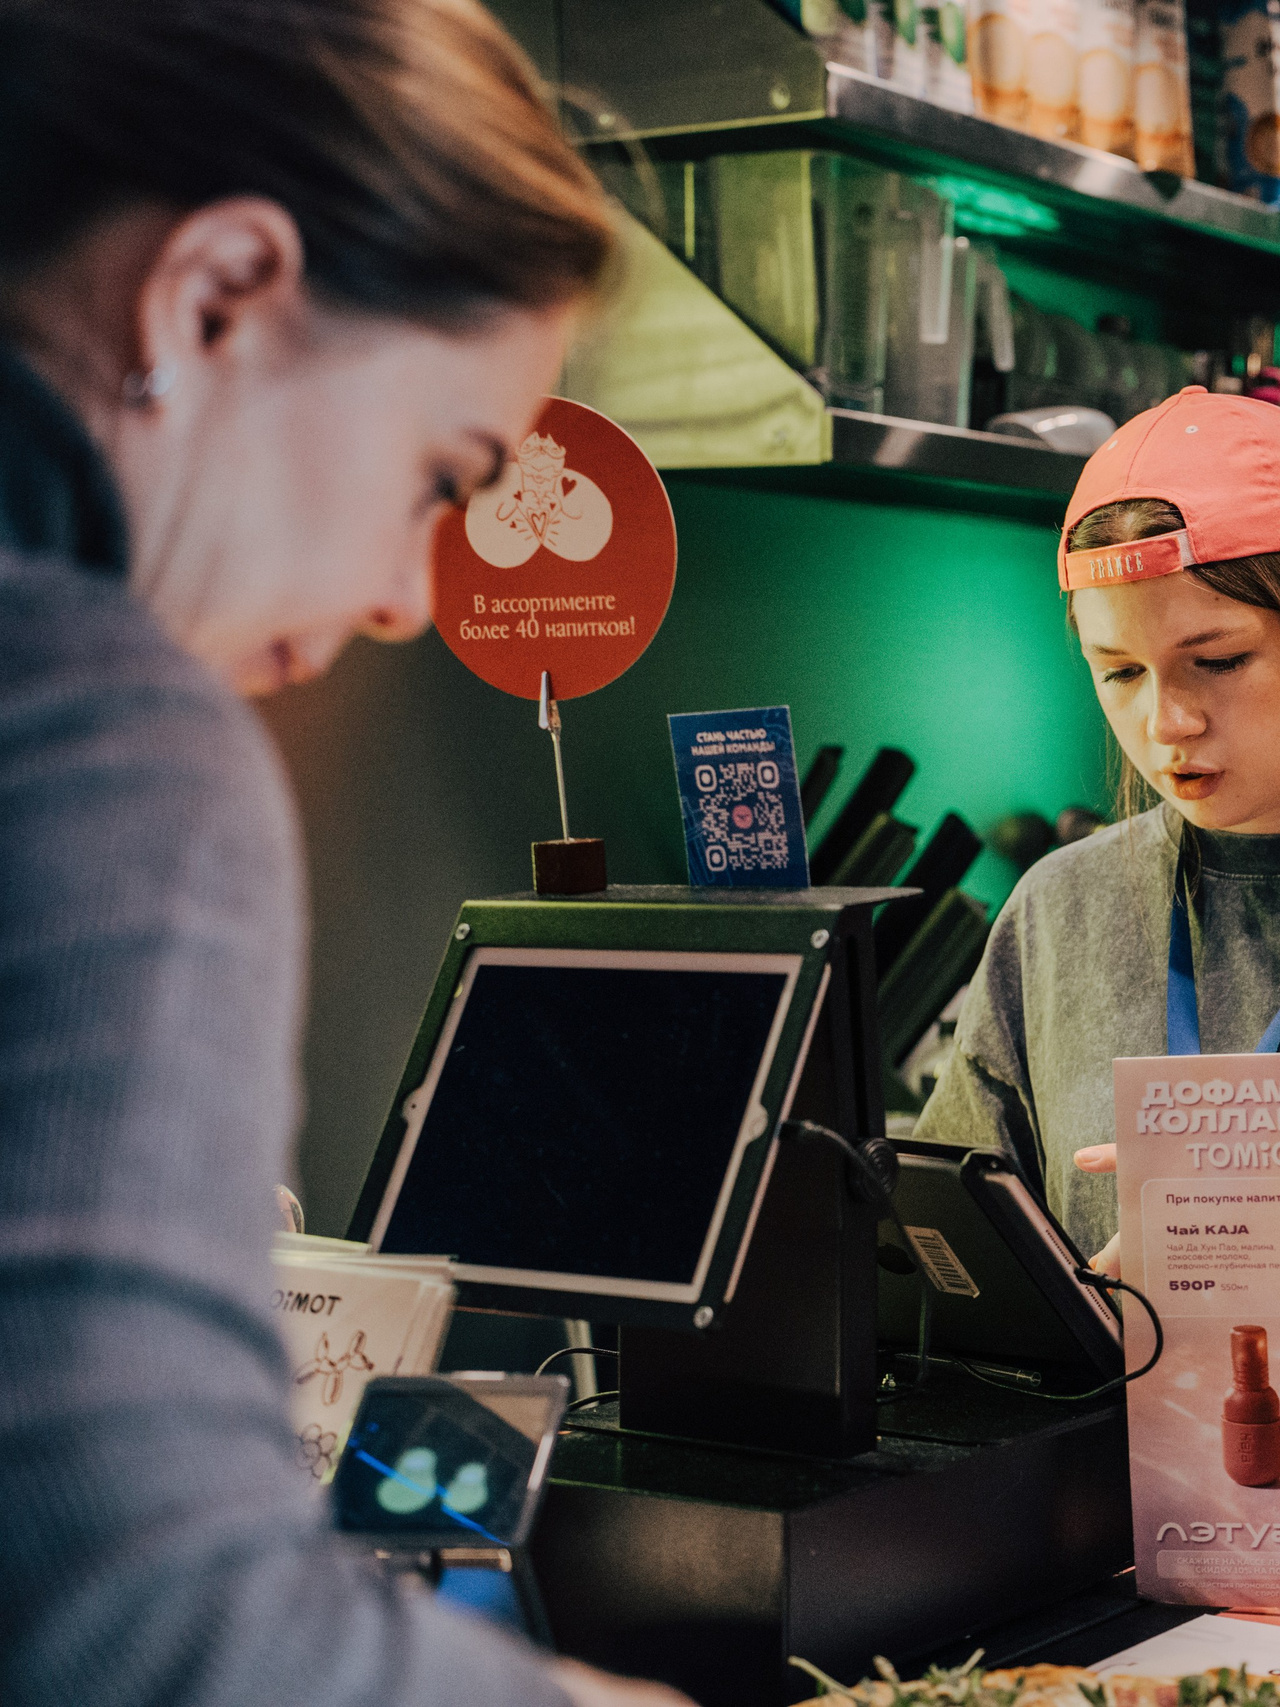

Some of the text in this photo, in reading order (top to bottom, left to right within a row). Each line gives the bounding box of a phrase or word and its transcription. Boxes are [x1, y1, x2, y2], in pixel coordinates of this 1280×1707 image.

[1089, 552, 1144, 580] FRANCE
[473, 594, 616, 620] В ассортименте
[460, 616, 636, 640] более 40 напитков!
[696, 728, 767, 743] СТАНЬ ЧАСТЬЮ
[691, 741, 776, 756] НАШЕЙ КОМАНДЫ
[1166, 1194, 1190, 1206] При
[1193, 1194, 1243, 1206] покупке
[1166, 1224, 1250, 1235] Чай KAJA
[1166, 1243, 1184, 1251] Чай
[1186, 1243, 1198, 1252] Да
[1201, 1243, 1217, 1252] Хун
[1167, 1253, 1214, 1261] кокосовое
[1176, 1556, 1220, 1565] СКАЖИТЕ
[1221, 1557, 1235, 1565] НА
[1237, 1557, 1266, 1566] КАССЕ
[1195, 1566, 1232, 1575] СКИДКУ
[1253, 1567, 1267, 1575] НА
